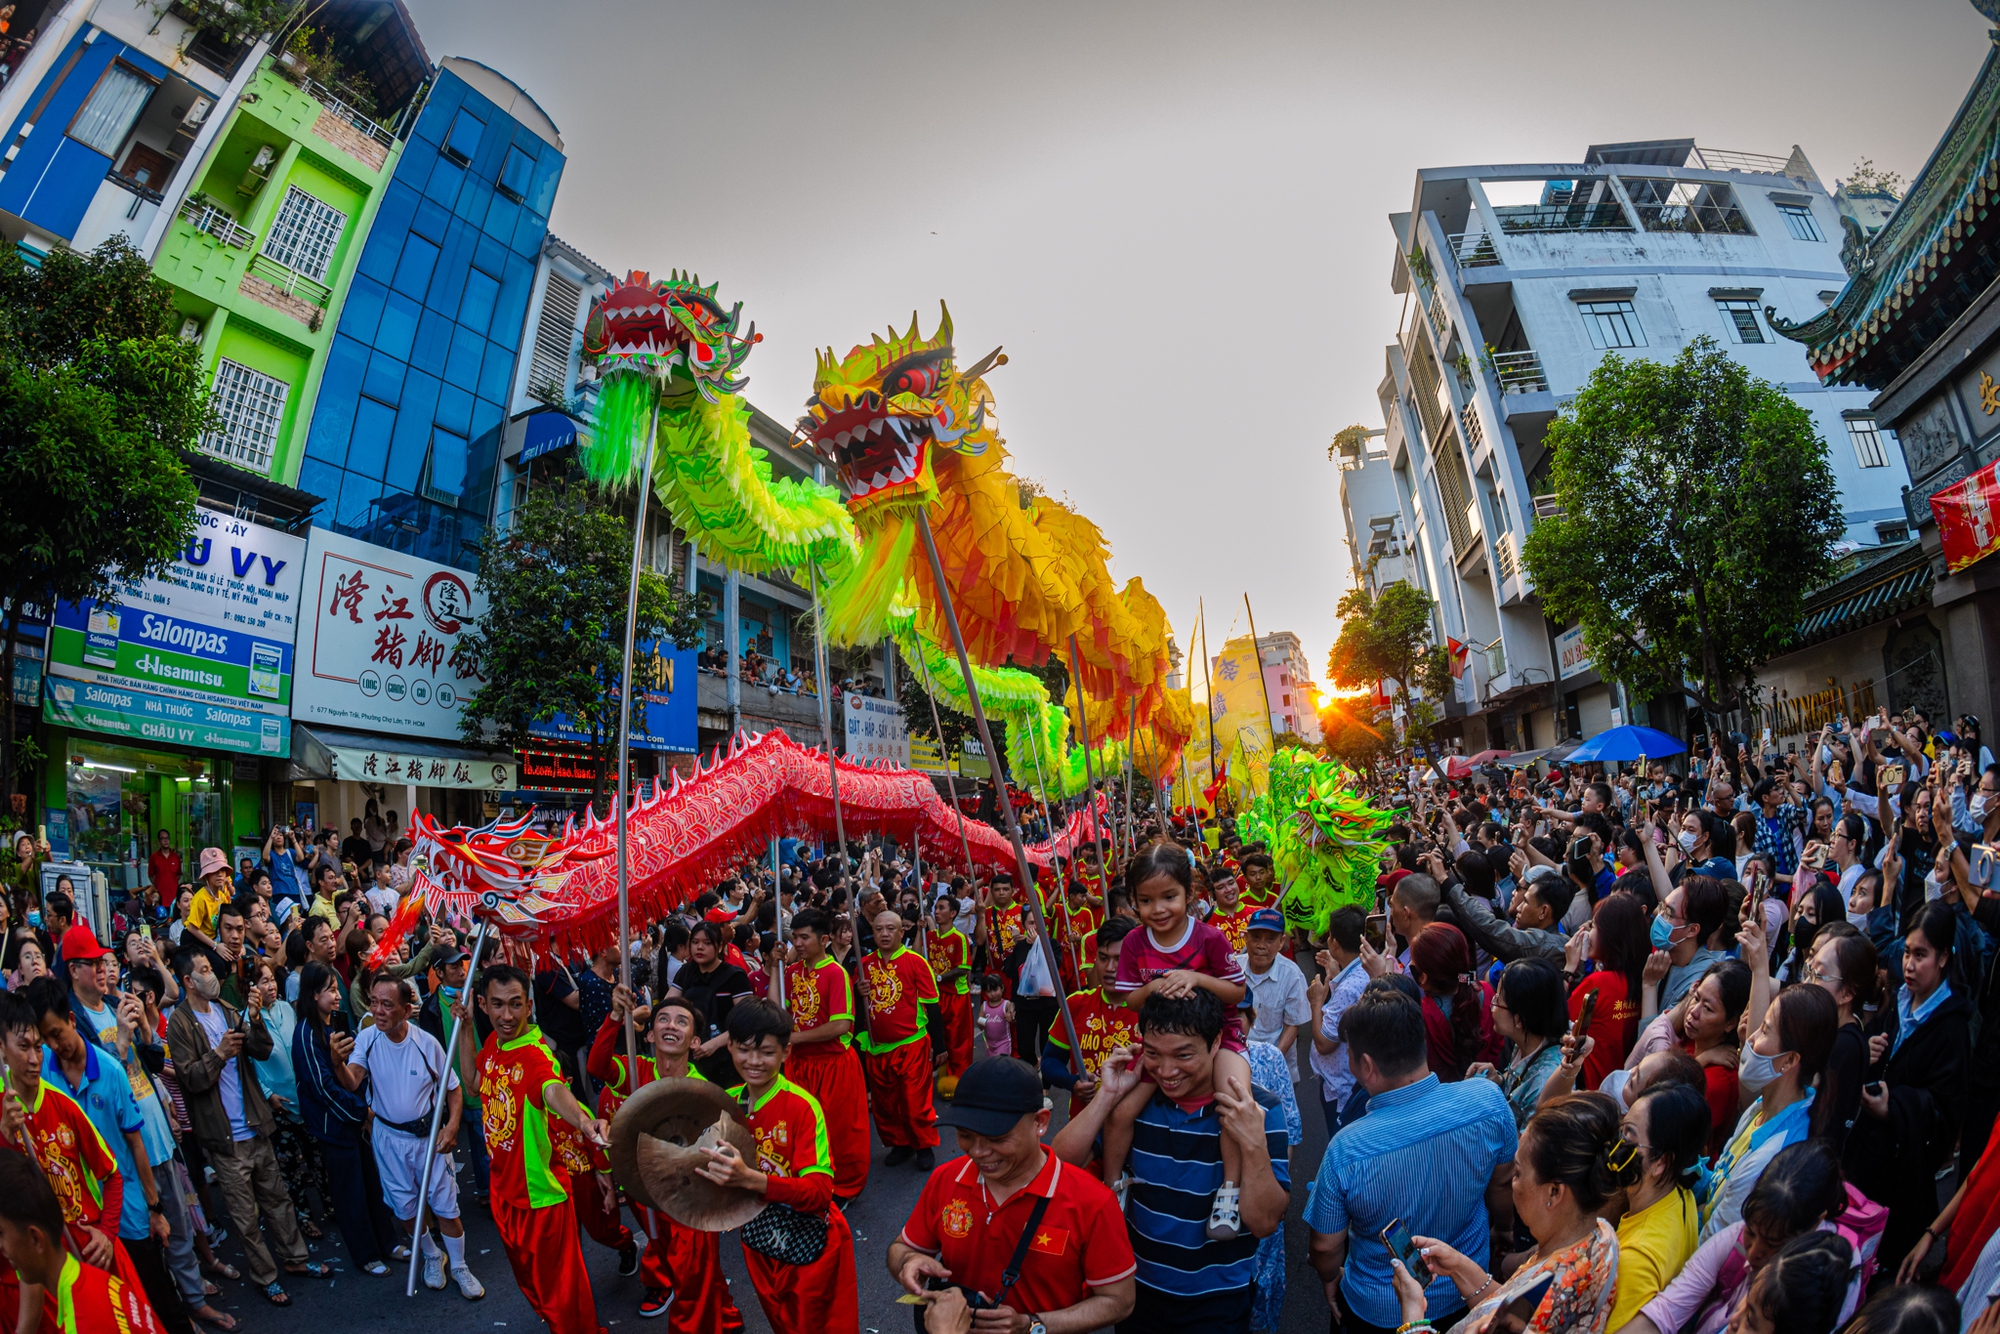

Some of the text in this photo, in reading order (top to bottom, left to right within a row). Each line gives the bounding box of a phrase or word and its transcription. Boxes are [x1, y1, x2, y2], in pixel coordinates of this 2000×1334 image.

[231, 546, 287, 587] VY
[329, 569, 415, 624] 隆江
[89, 633, 115, 647] Salonpas
[139, 613, 228, 654] Salonpas
[135, 654, 222, 687] Hisamitsu
[85, 686, 132, 708] Salonpas
[207, 695, 237, 706] HISAMITSU
[239, 699, 250, 709] VIỆT
[251, 702, 263, 710] NAM
[145, 699, 194, 718] NHÀ THUỐC
[205, 707, 251, 727] Salonpas
[317, 706, 327, 714] 677
[412, 720, 425, 728] HCM
[83, 713, 131, 731] Hisamitsu
[141, 722, 195, 742] CHÂU VY
[204, 732, 250, 748] Hisamitsu
